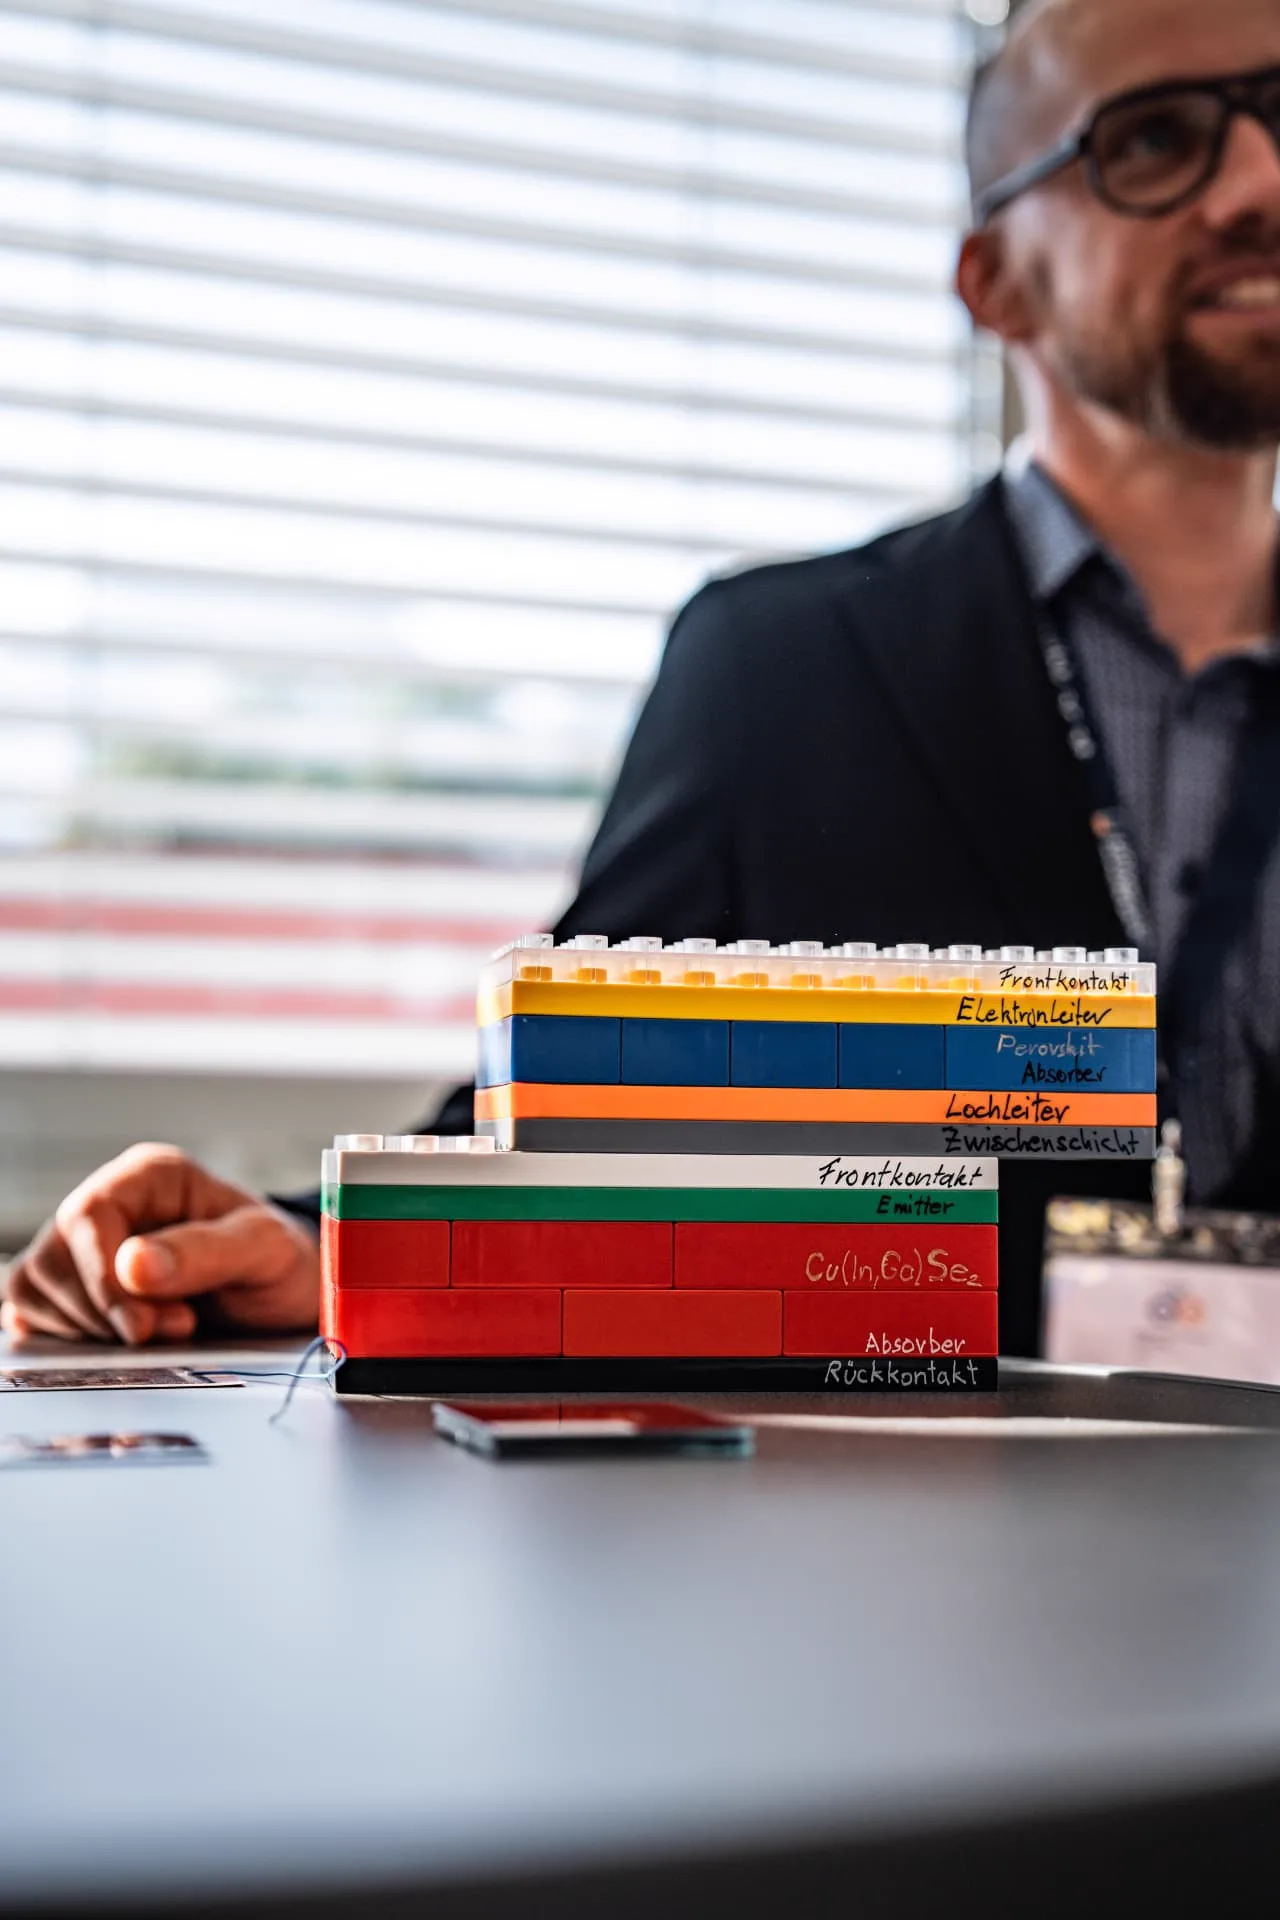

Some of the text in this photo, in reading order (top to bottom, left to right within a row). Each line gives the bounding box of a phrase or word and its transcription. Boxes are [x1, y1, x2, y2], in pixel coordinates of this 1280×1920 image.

[999, 965, 1130, 992] Frontkontakt
[996, 1031, 1104, 1058] Perovskit
[1021, 1055, 1108, 1085] Absorber
[945, 1092, 1070, 1124] Lochleiter
[942, 1126, 1140, 1156] Zwischenschicht
[818, 1157, 983, 1188] Frontkontakt
[876, 1194, 955, 1216] Emitter
[865, 1326, 966, 1355] Absorber
[824, 1358, 979, 1387] Rückkontakt
